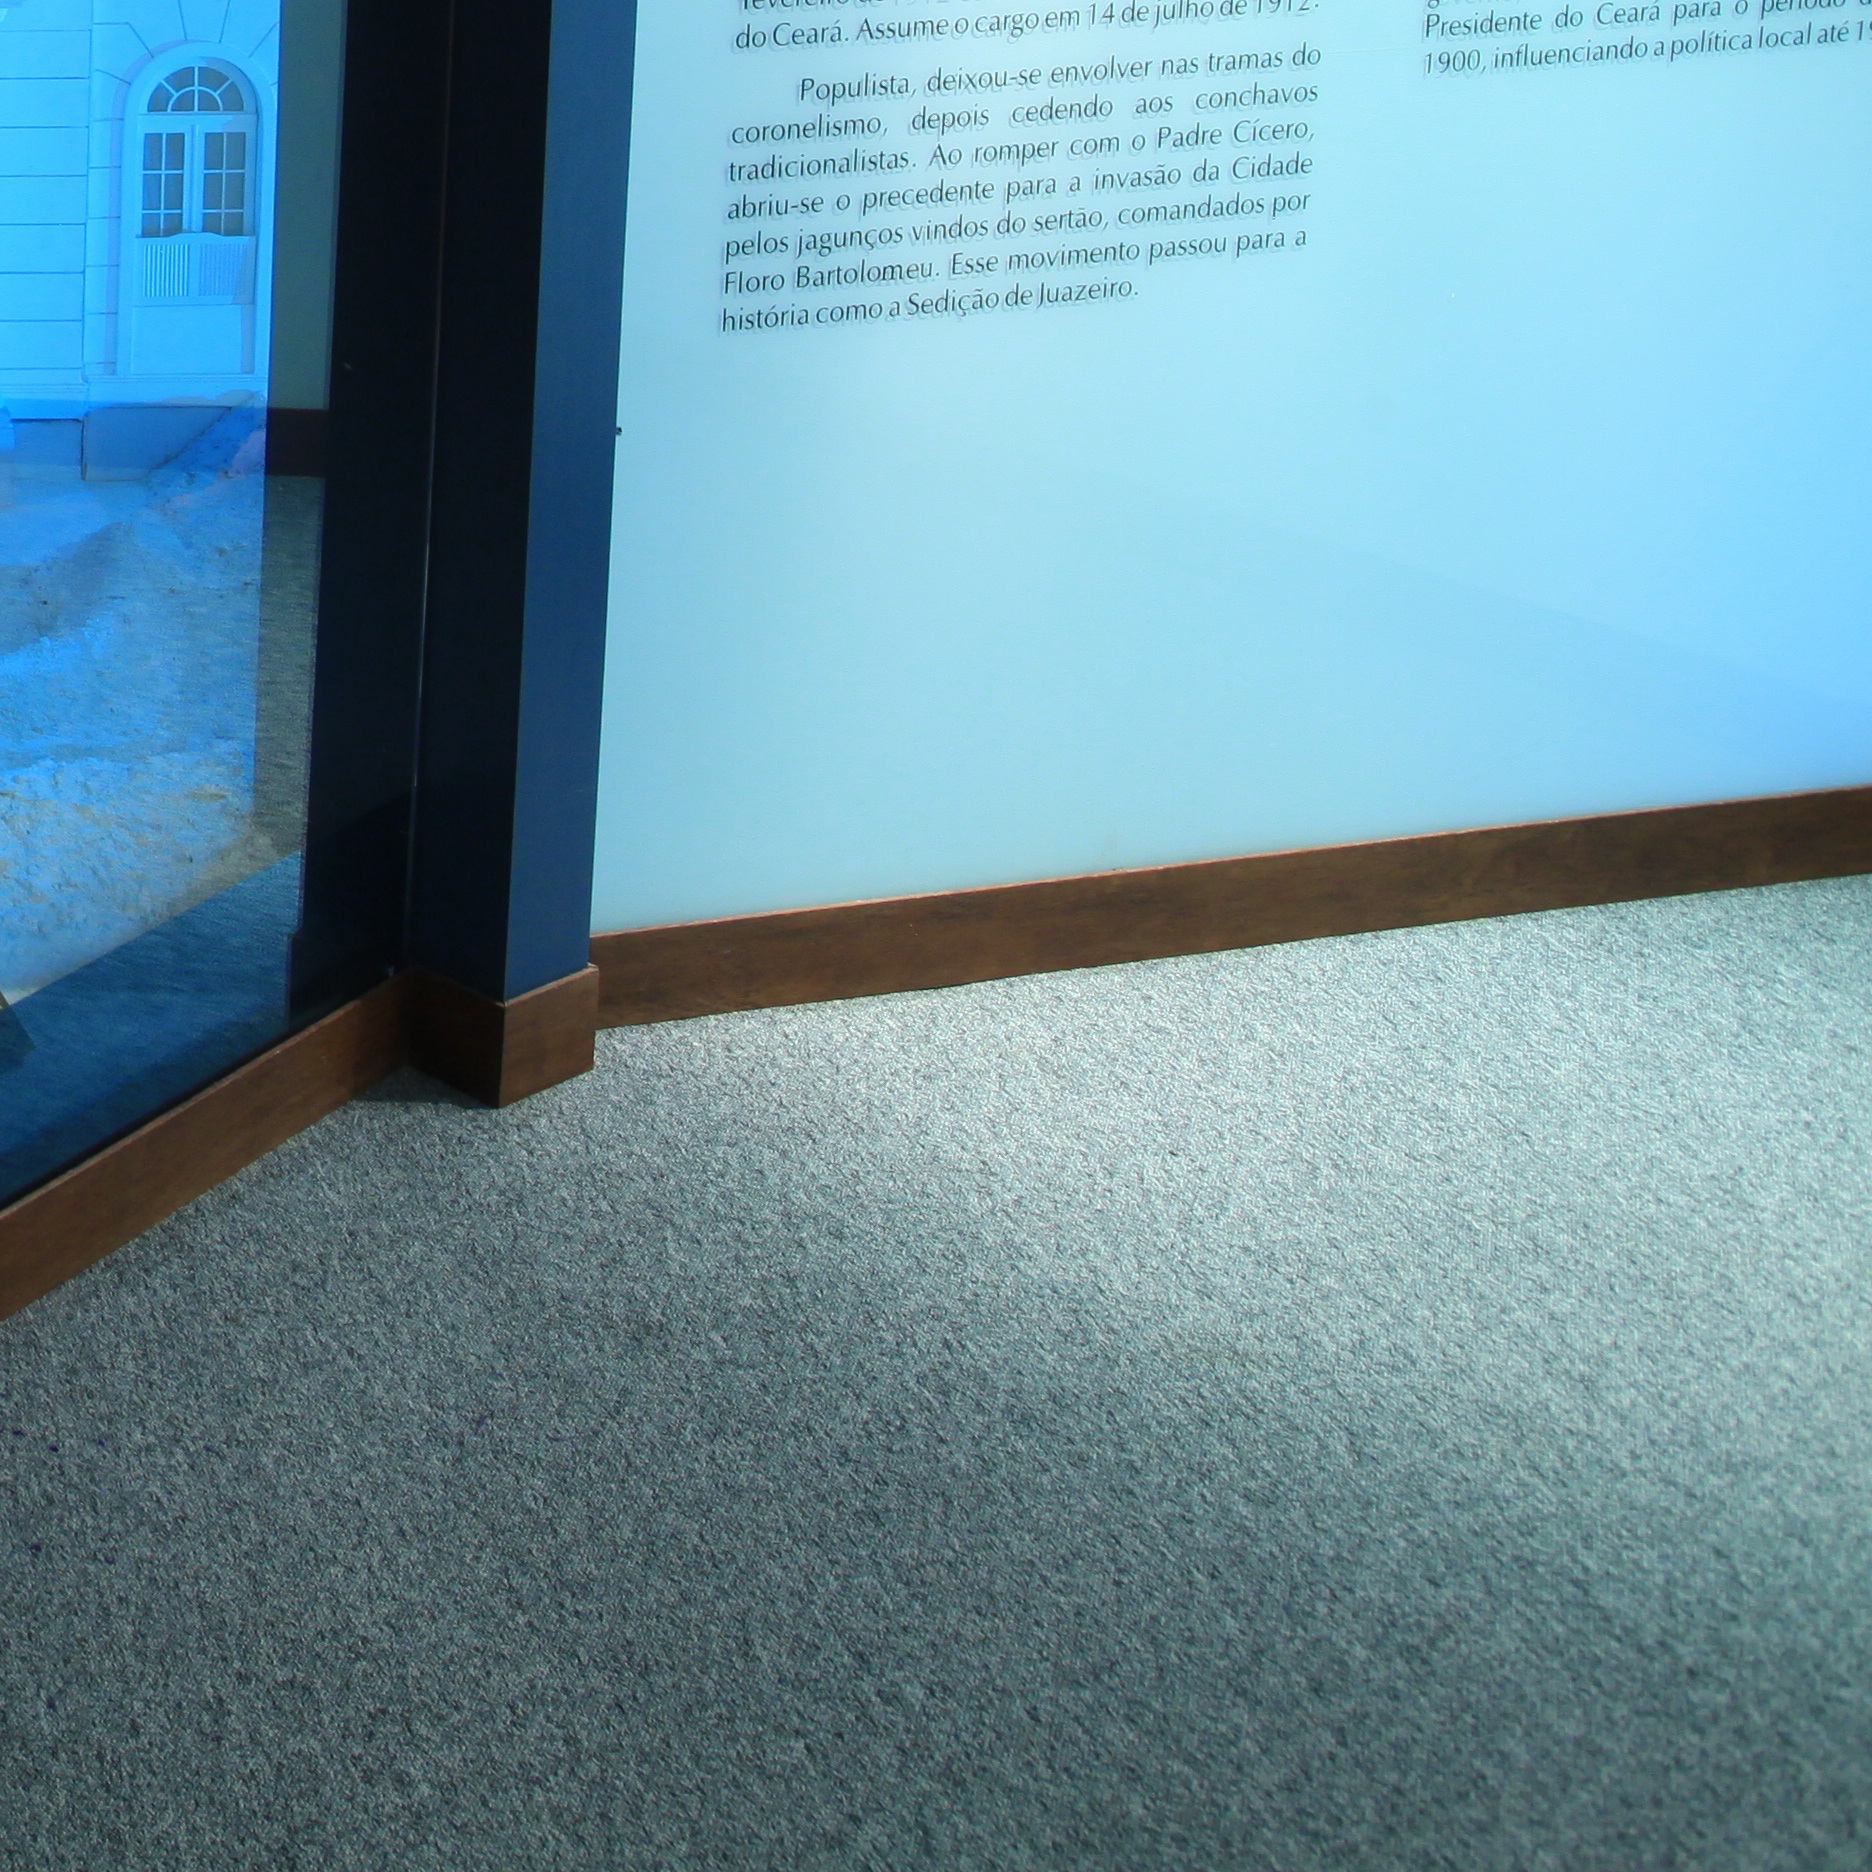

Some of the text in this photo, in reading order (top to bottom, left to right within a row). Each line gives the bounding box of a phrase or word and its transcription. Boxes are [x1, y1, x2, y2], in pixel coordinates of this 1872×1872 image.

[1425, 22, 1849, 74] 1900, influenciando a política local até
[722, 276, 1139, 332] história como a Sedição de Juazeiro.
